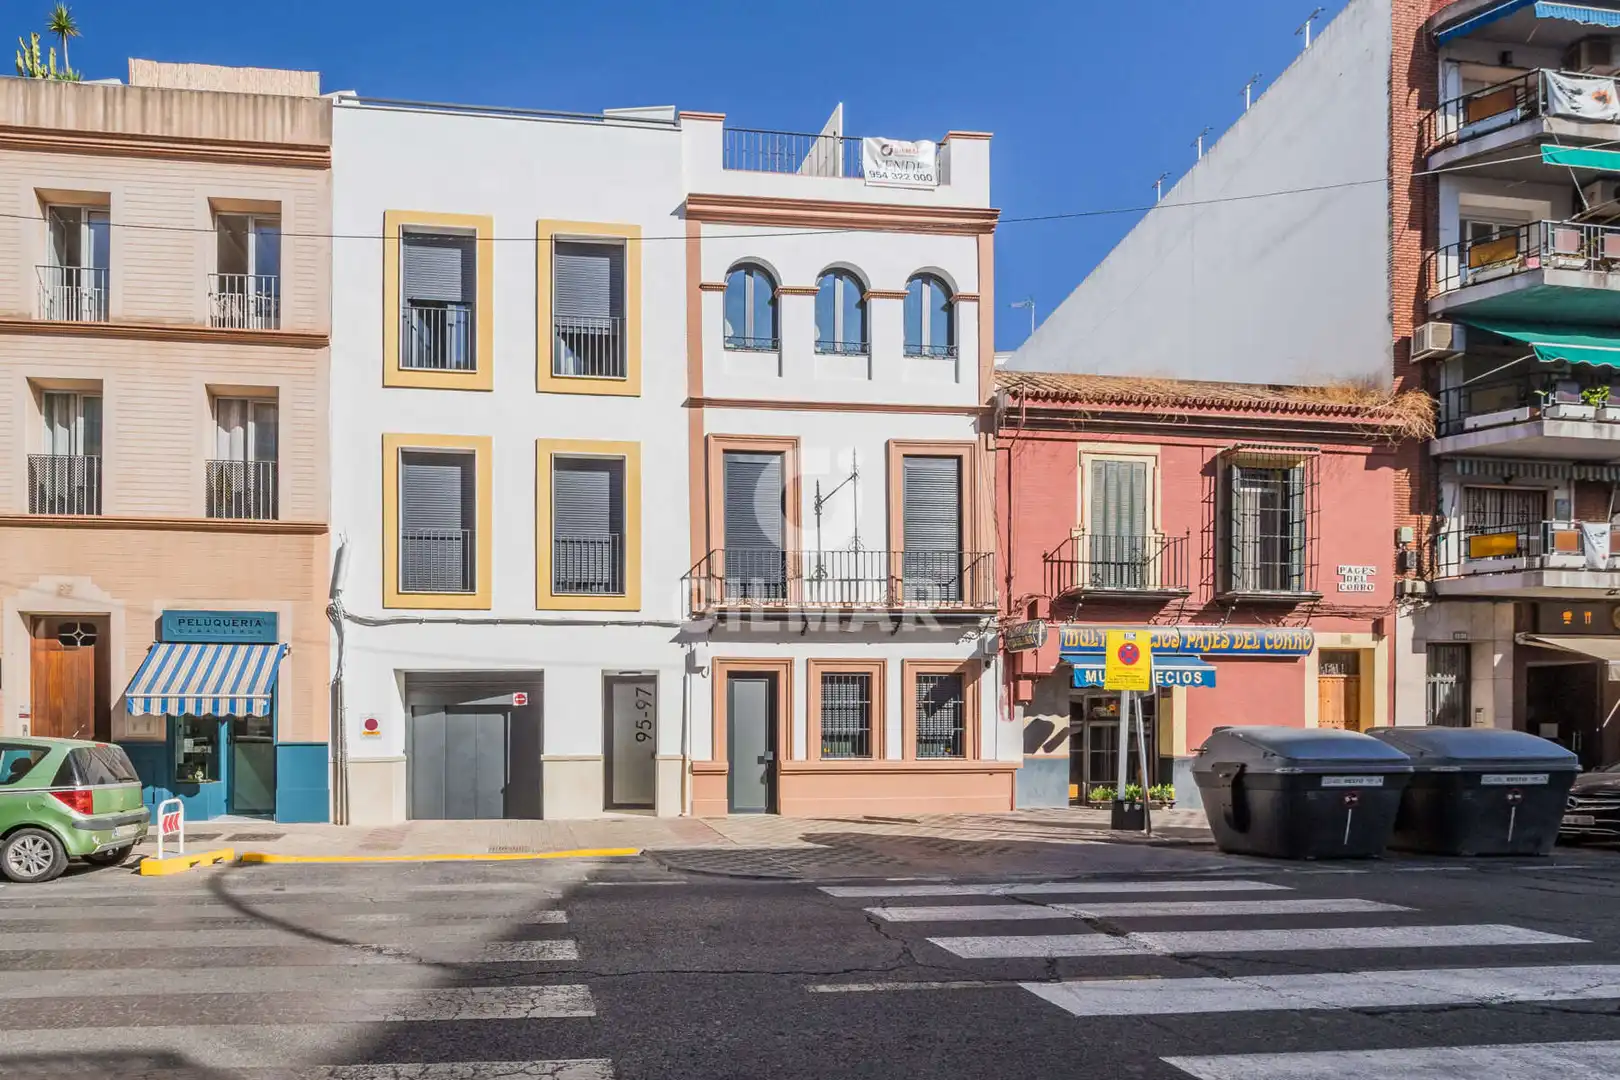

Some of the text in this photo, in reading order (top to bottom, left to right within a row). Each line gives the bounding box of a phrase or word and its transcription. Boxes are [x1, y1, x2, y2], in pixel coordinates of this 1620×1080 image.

[869, 170, 933, 182] 954 322 000
[1339, 583, 1374, 591] CORRO
[178, 618, 262, 627] PELUQUERIA
[1232, 632, 1261, 649] DEL
[1264, 632, 1313, 650] CORRO
[635, 687, 652, 742] 95-97
